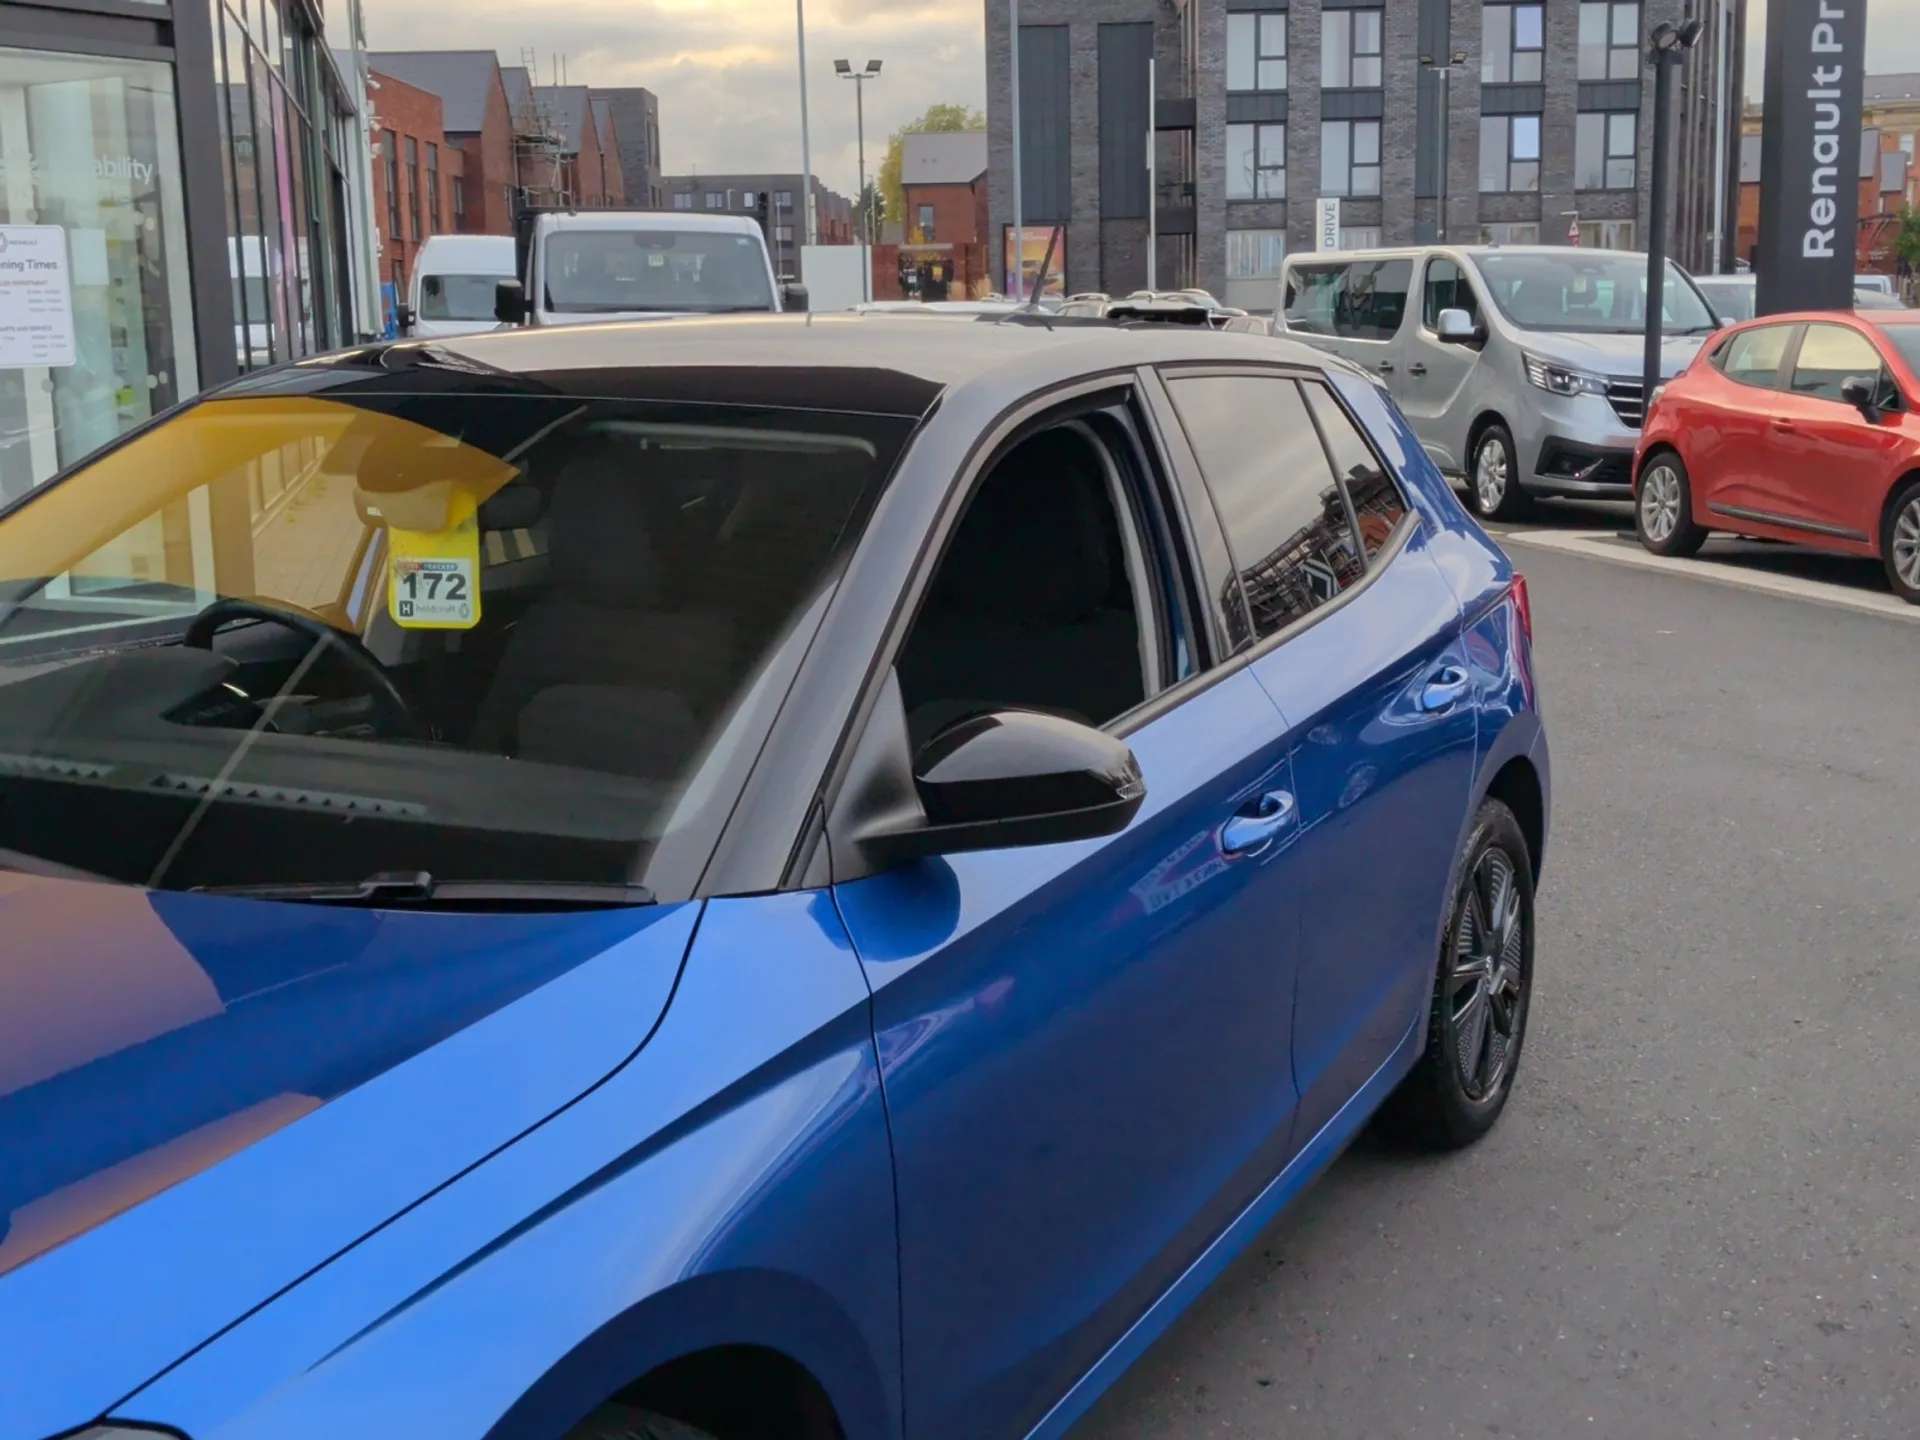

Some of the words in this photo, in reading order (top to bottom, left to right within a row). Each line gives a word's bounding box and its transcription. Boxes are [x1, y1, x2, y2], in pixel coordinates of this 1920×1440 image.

[1811, 0, 1844, 53] Pr
[1803, 65, 1842, 258] Renault
[1324, 203, 1336, 247] DRIVE
[25, 259, 57, 270] Times
[403, 573, 467, 600] 172
